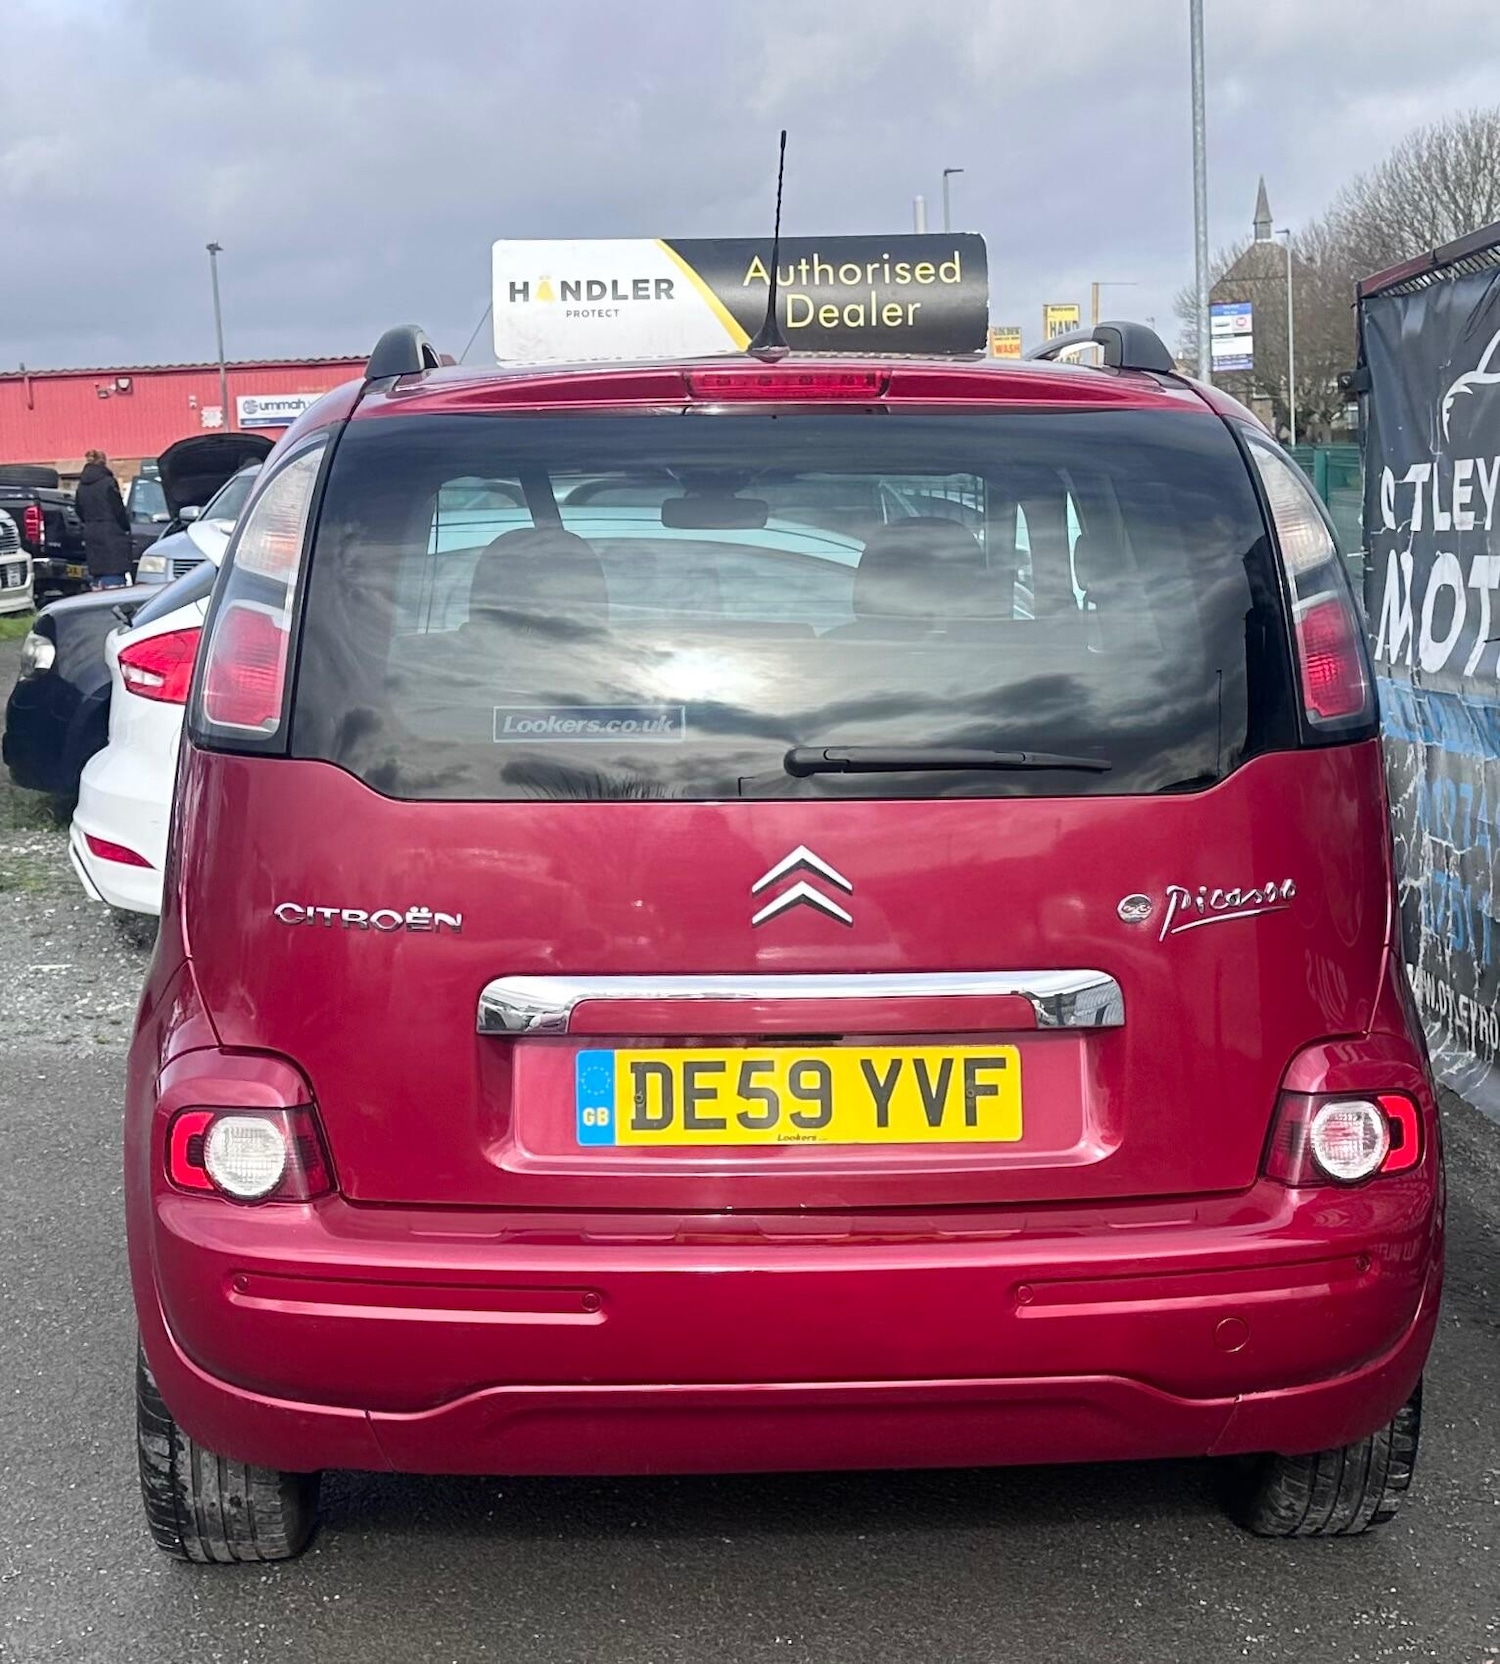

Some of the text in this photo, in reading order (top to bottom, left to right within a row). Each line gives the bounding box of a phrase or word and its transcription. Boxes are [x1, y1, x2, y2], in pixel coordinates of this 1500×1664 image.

[743, 251, 961, 287] Authorised
[566, 309, 620, 318] PROTECT
[786, 291, 921, 329] Dealer
[1380, 455, 1500, 532] OTLEY
[1374, 548, 1500, 679] MOT
[502, 715, 673, 733] Lookers.co.uk
[274, 902, 463, 933] CITROËN
[1159, 878, 1297, 942] Picasso
[630, 1057, 1007, 1130] DE59 YVF
[583, 1107, 610, 1126] GB
[777, 1133, 817, 1142] Lookers
